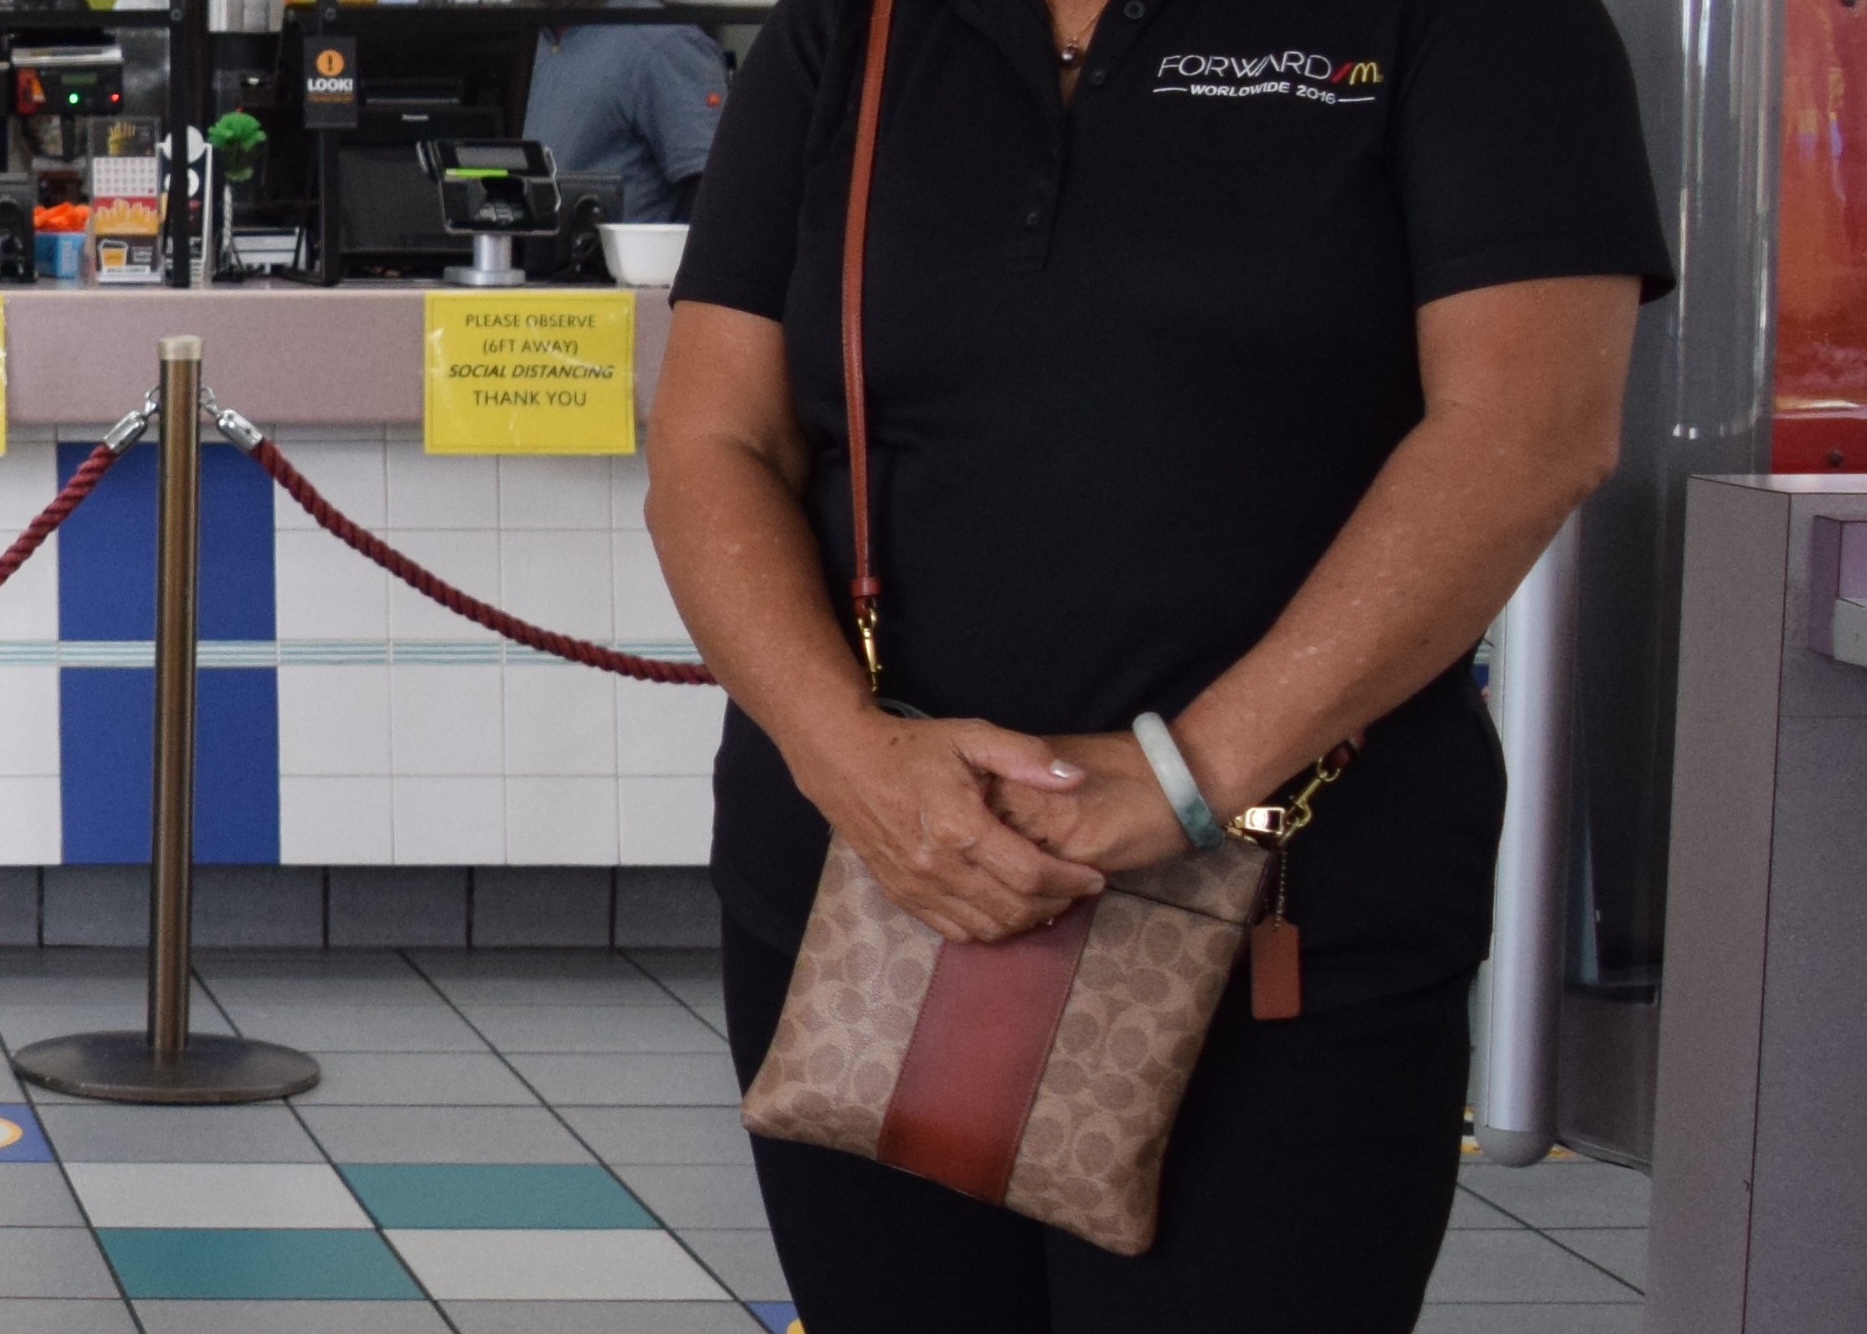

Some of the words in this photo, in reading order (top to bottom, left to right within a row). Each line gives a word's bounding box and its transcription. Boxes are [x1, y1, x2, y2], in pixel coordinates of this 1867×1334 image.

[1157, 51, 1332, 79] FORWARD
[307, 78, 354, 92] LOOK!
[1190, 81, 1291, 97] WORLDWIDE
[1296, 85, 1337, 105] 2016
[466, 314, 520, 328] PLEASE
[526, 314, 595, 328] OBSERVE
[483, 339, 516, 355] (6FT
[521, 339, 579, 355] AWAY)
[449, 364, 508, 379] SOCIAL
[511, 364, 615, 379] DISTANCING
[473, 390, 541, 406] THANK
[546, 390, 587, 407] YOU
